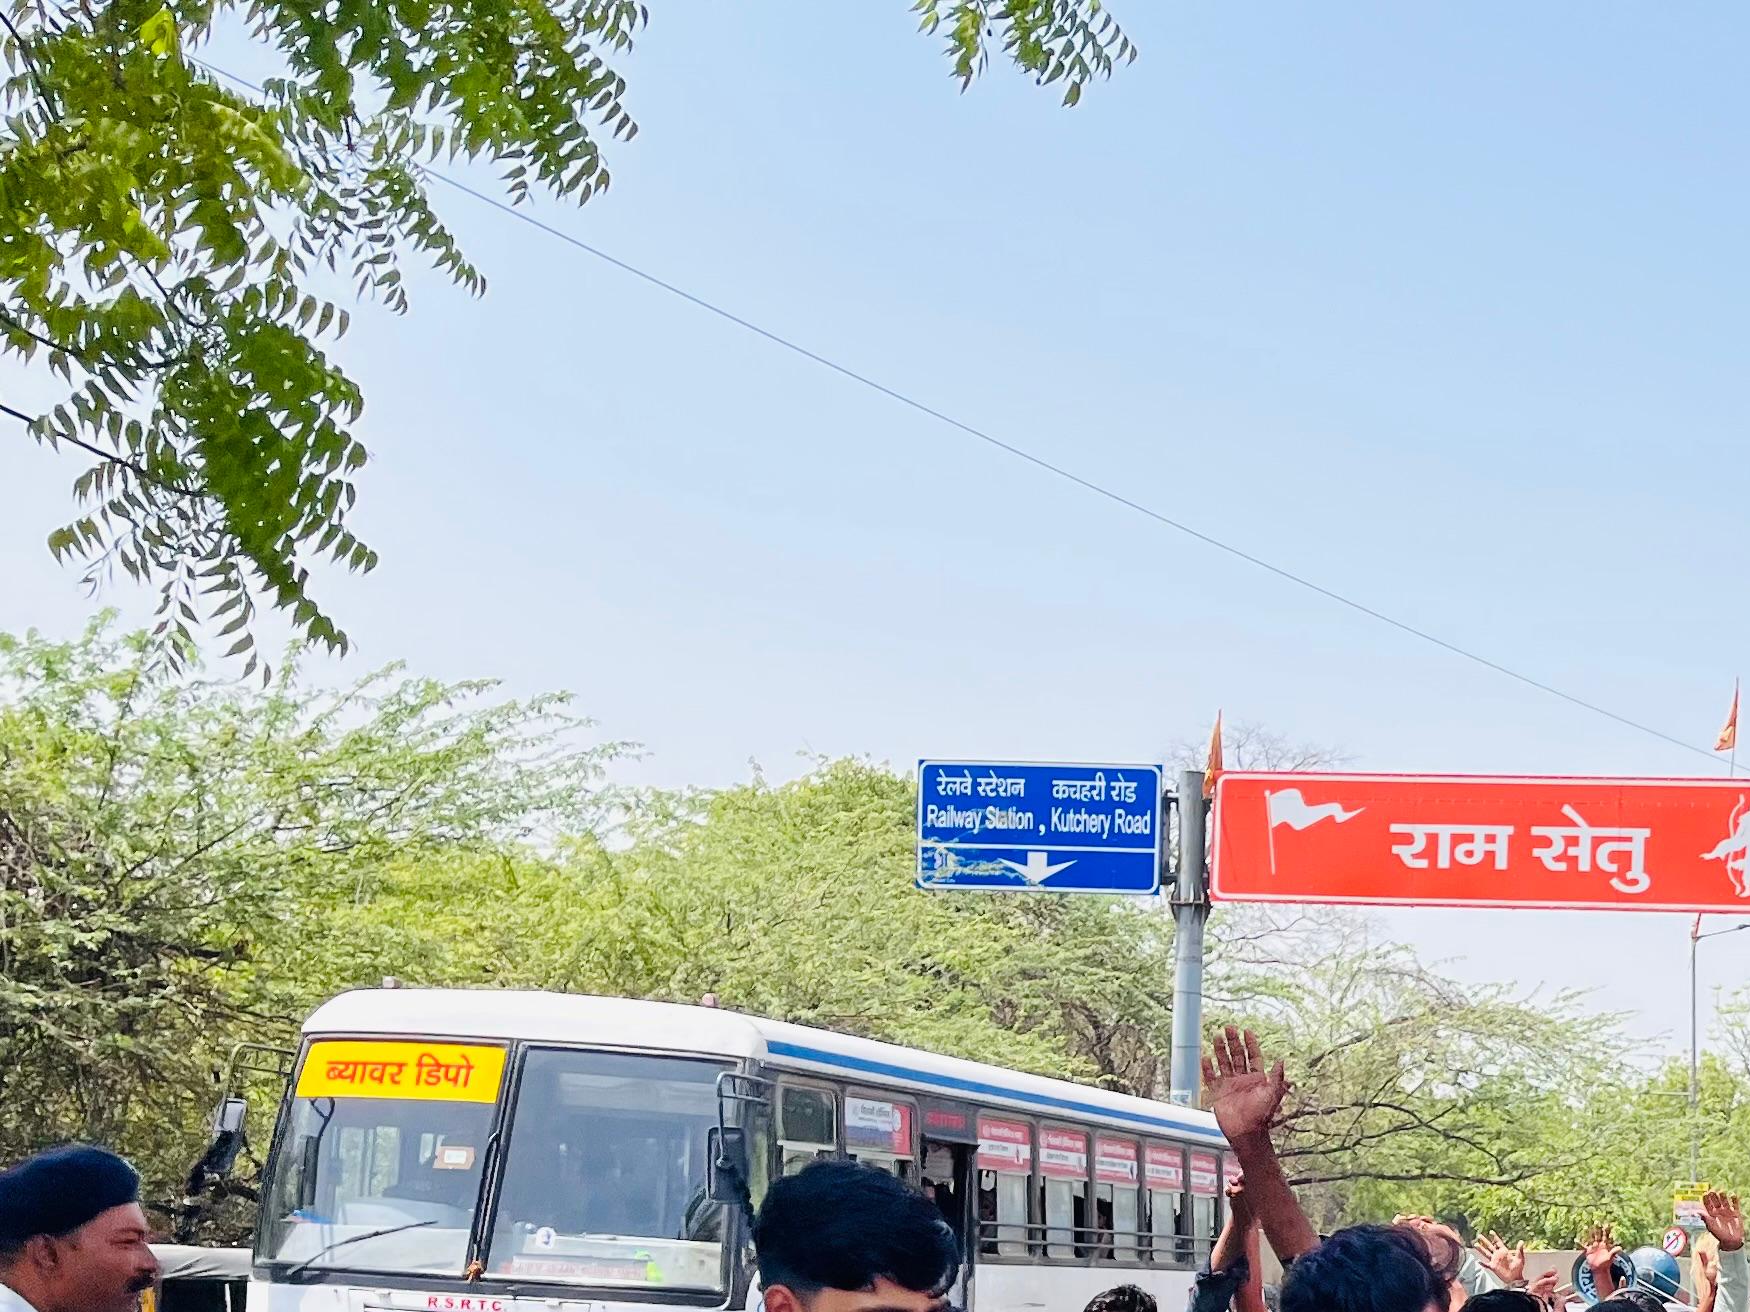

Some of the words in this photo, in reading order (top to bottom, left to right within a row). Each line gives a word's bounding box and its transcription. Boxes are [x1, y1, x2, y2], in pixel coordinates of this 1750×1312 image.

[936, 769, 973, 797] रेलवे
[976, 769, 1026, 798] स्टेशन
[1052, 771, 1107, 802] कचहरी
[1110, 773, 1138, 803] रोड
[927, 804, 982, 835] Railway
[1051, 806, 1112, 840] Kutchery
[1114, 808, 1151, 835] Road
[1389, 822, 1514, 870] राम
[1531, 804, 1652, 893] सेतु
[326, 1061, 408, 1086] ब्यावर
[415, 1053, 475, 1088] डिपो
